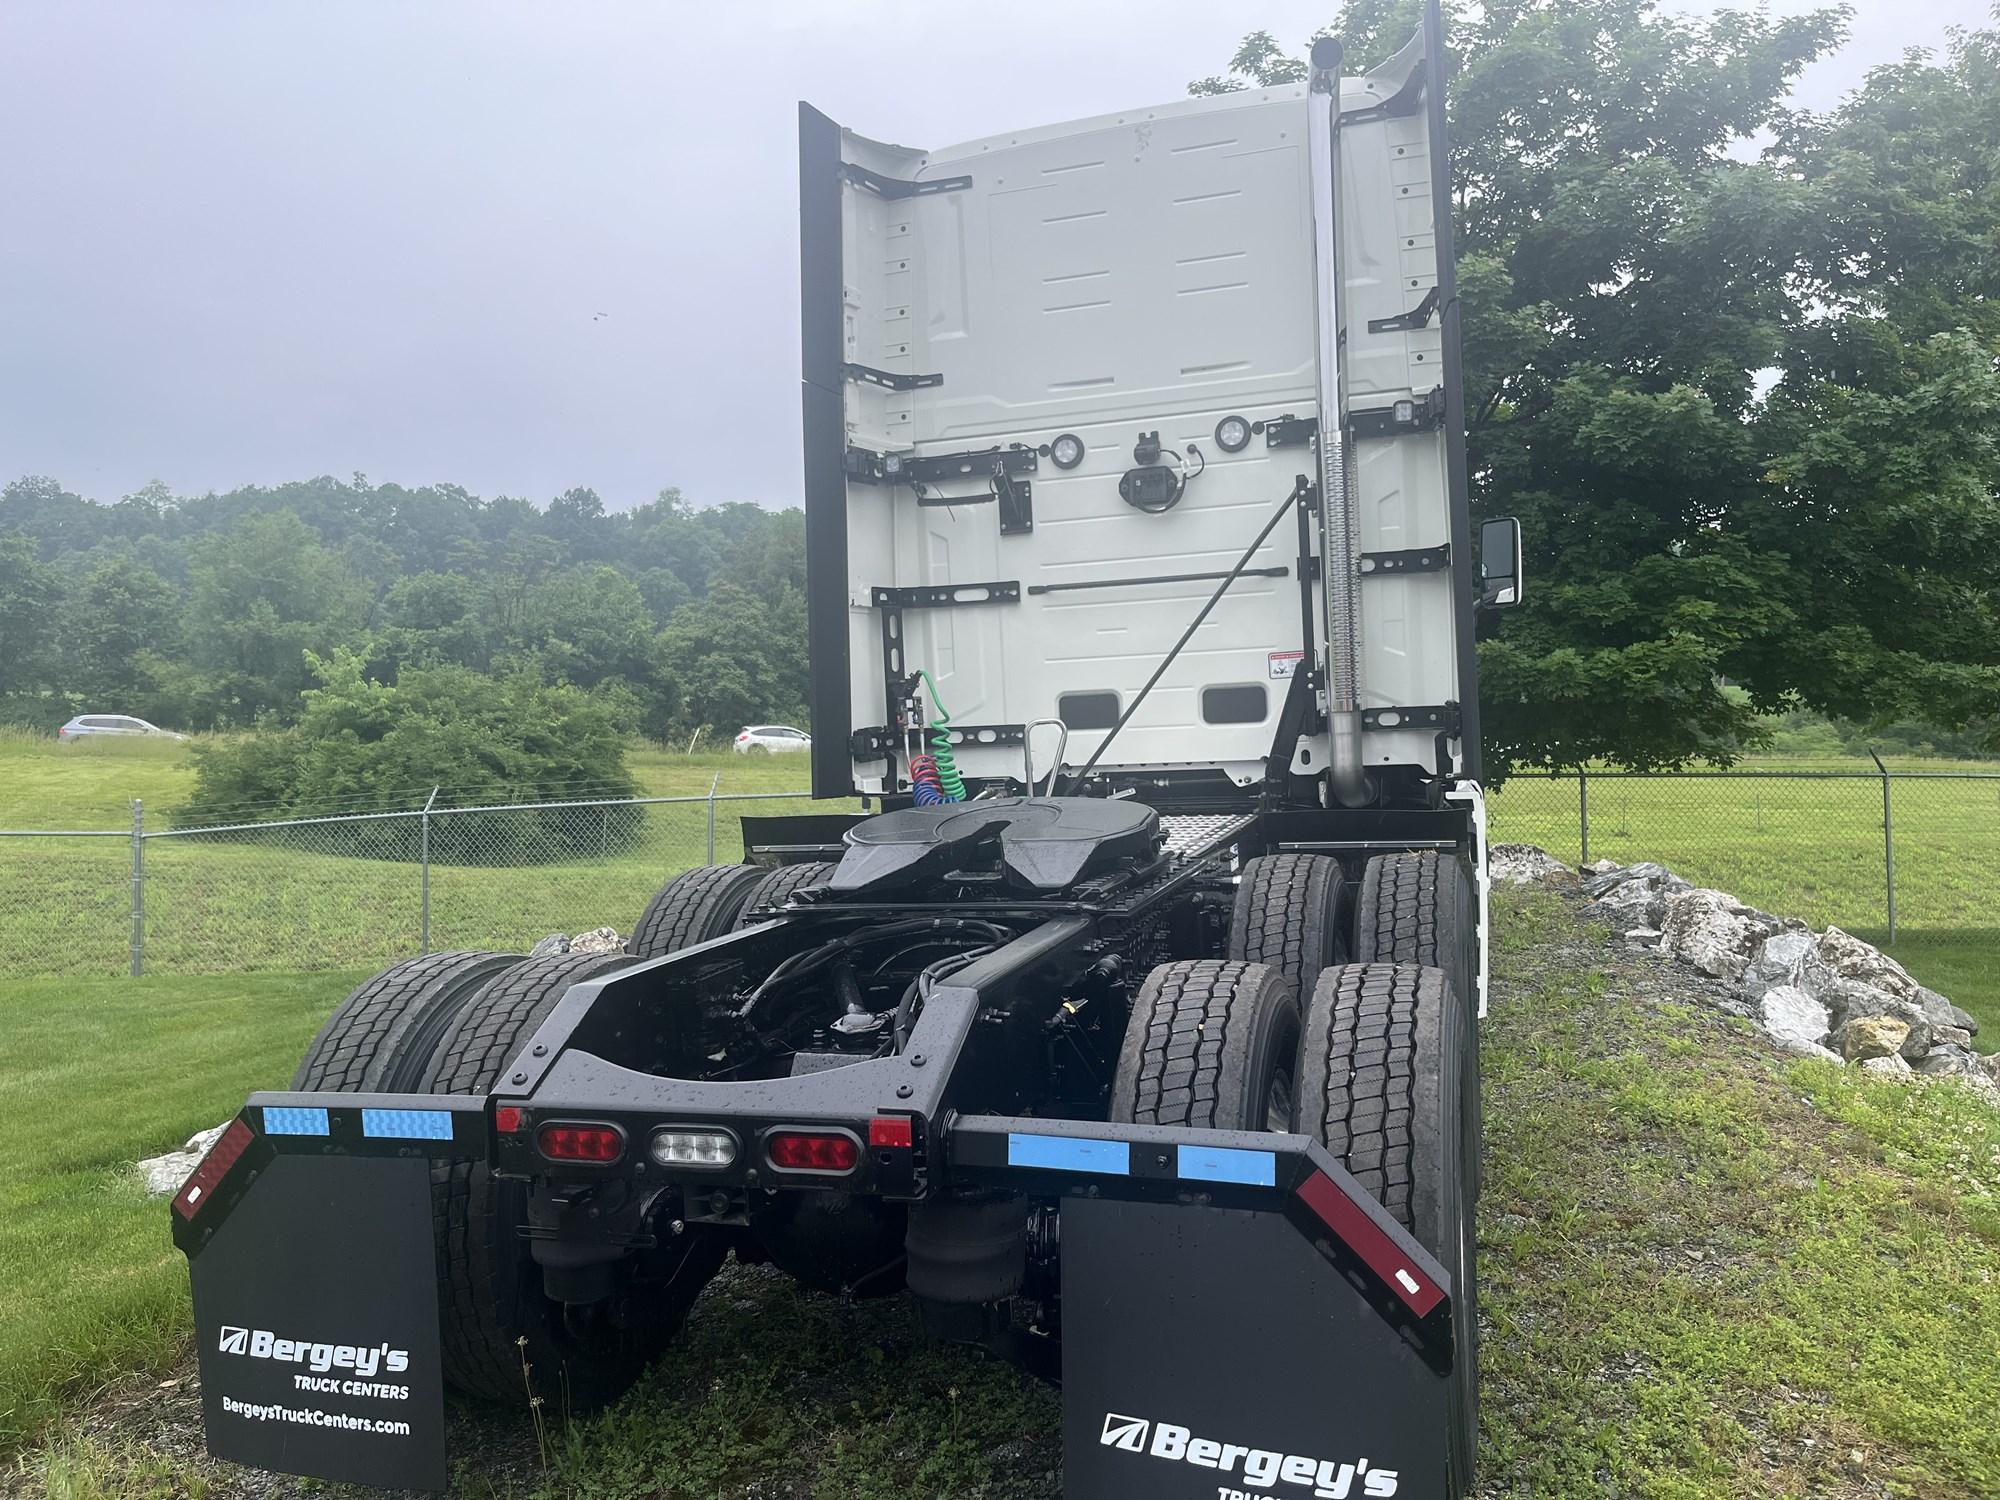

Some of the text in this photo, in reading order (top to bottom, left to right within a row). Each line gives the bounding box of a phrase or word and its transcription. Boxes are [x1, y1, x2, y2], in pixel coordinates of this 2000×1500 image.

[249, 1329, 409, 1377] Bergey's
[294, 1374, 409, 1400] TRUCK CENTERS
[223, 1396, 410, 1435] BergeysTruckCenters.com
[1149, 1422, 1399, 1500] Bergey's
